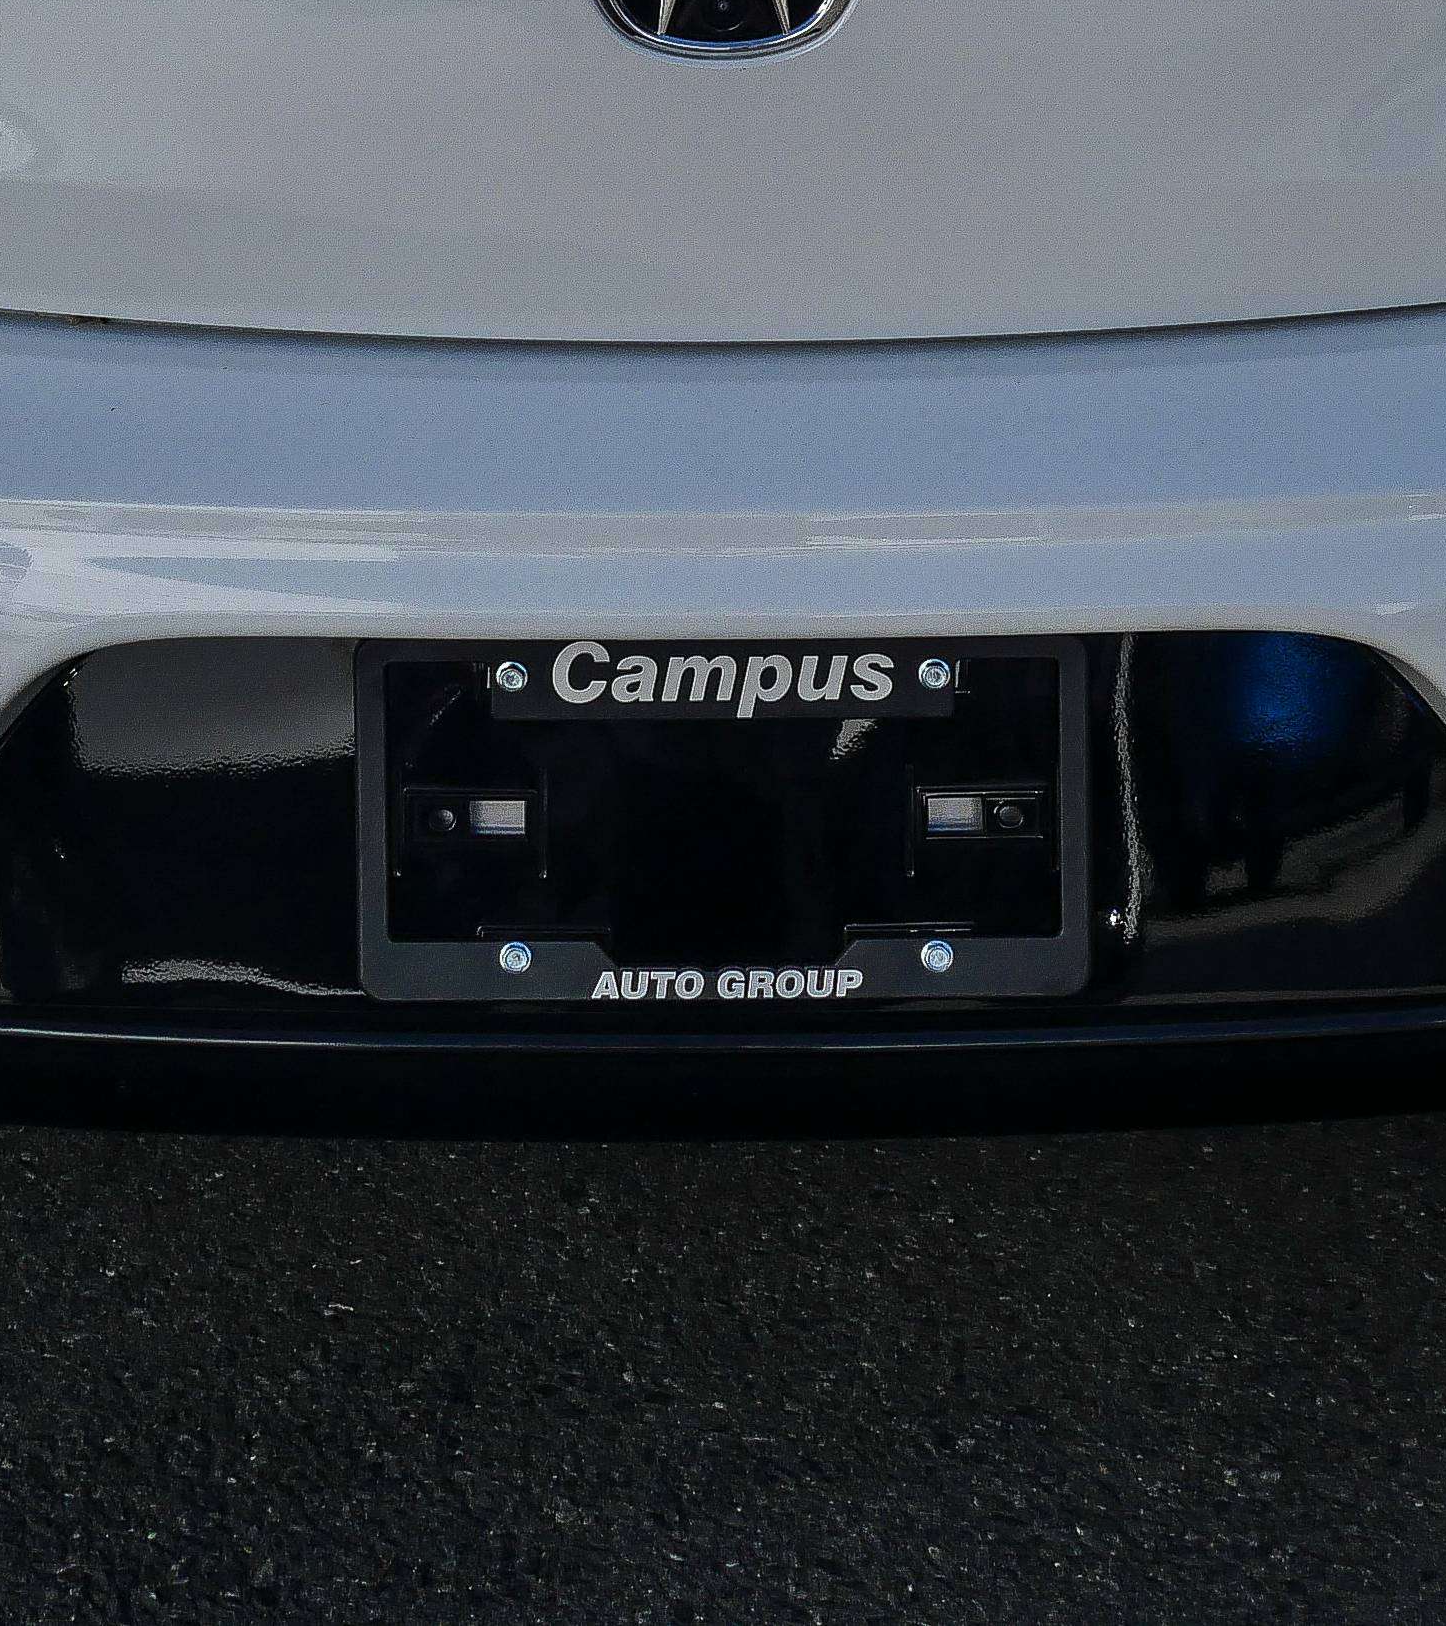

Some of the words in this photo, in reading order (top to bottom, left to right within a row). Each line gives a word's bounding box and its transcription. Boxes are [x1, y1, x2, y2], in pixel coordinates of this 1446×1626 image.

[552, 640, 894, 719] Campus
[591, 970, 705, 1000] AUTO
[717, 969, 863, 999] GROUP
